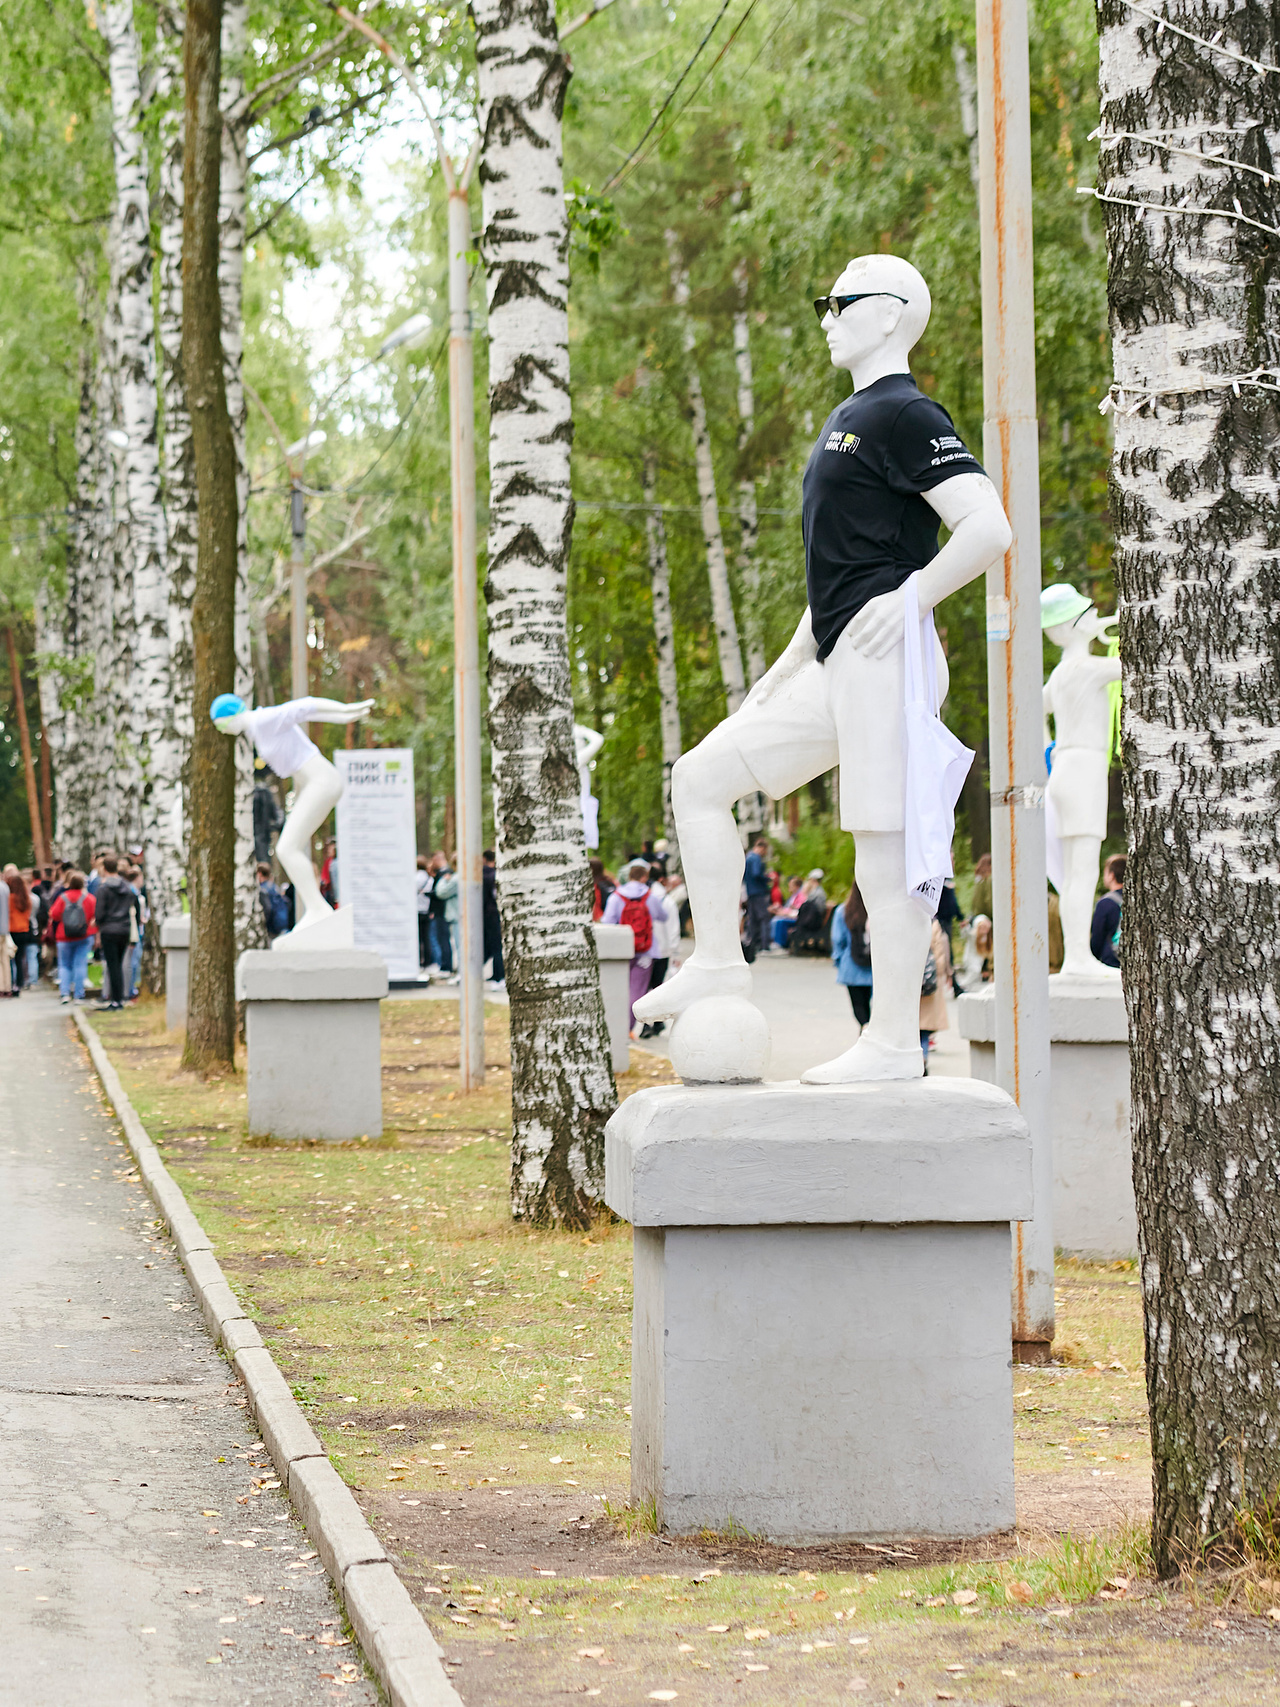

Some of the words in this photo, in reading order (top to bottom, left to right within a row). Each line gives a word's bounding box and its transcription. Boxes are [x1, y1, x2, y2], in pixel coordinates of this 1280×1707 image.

[829, 431, 845, 441] ПИК
[824, 441, 841, 452] НИК
[839, 442, 850, 453] IT
[348, 761, 381, 772] ПИК
[348, 774, 381, 785] НИК
[385, 773, 397, 785] IT
